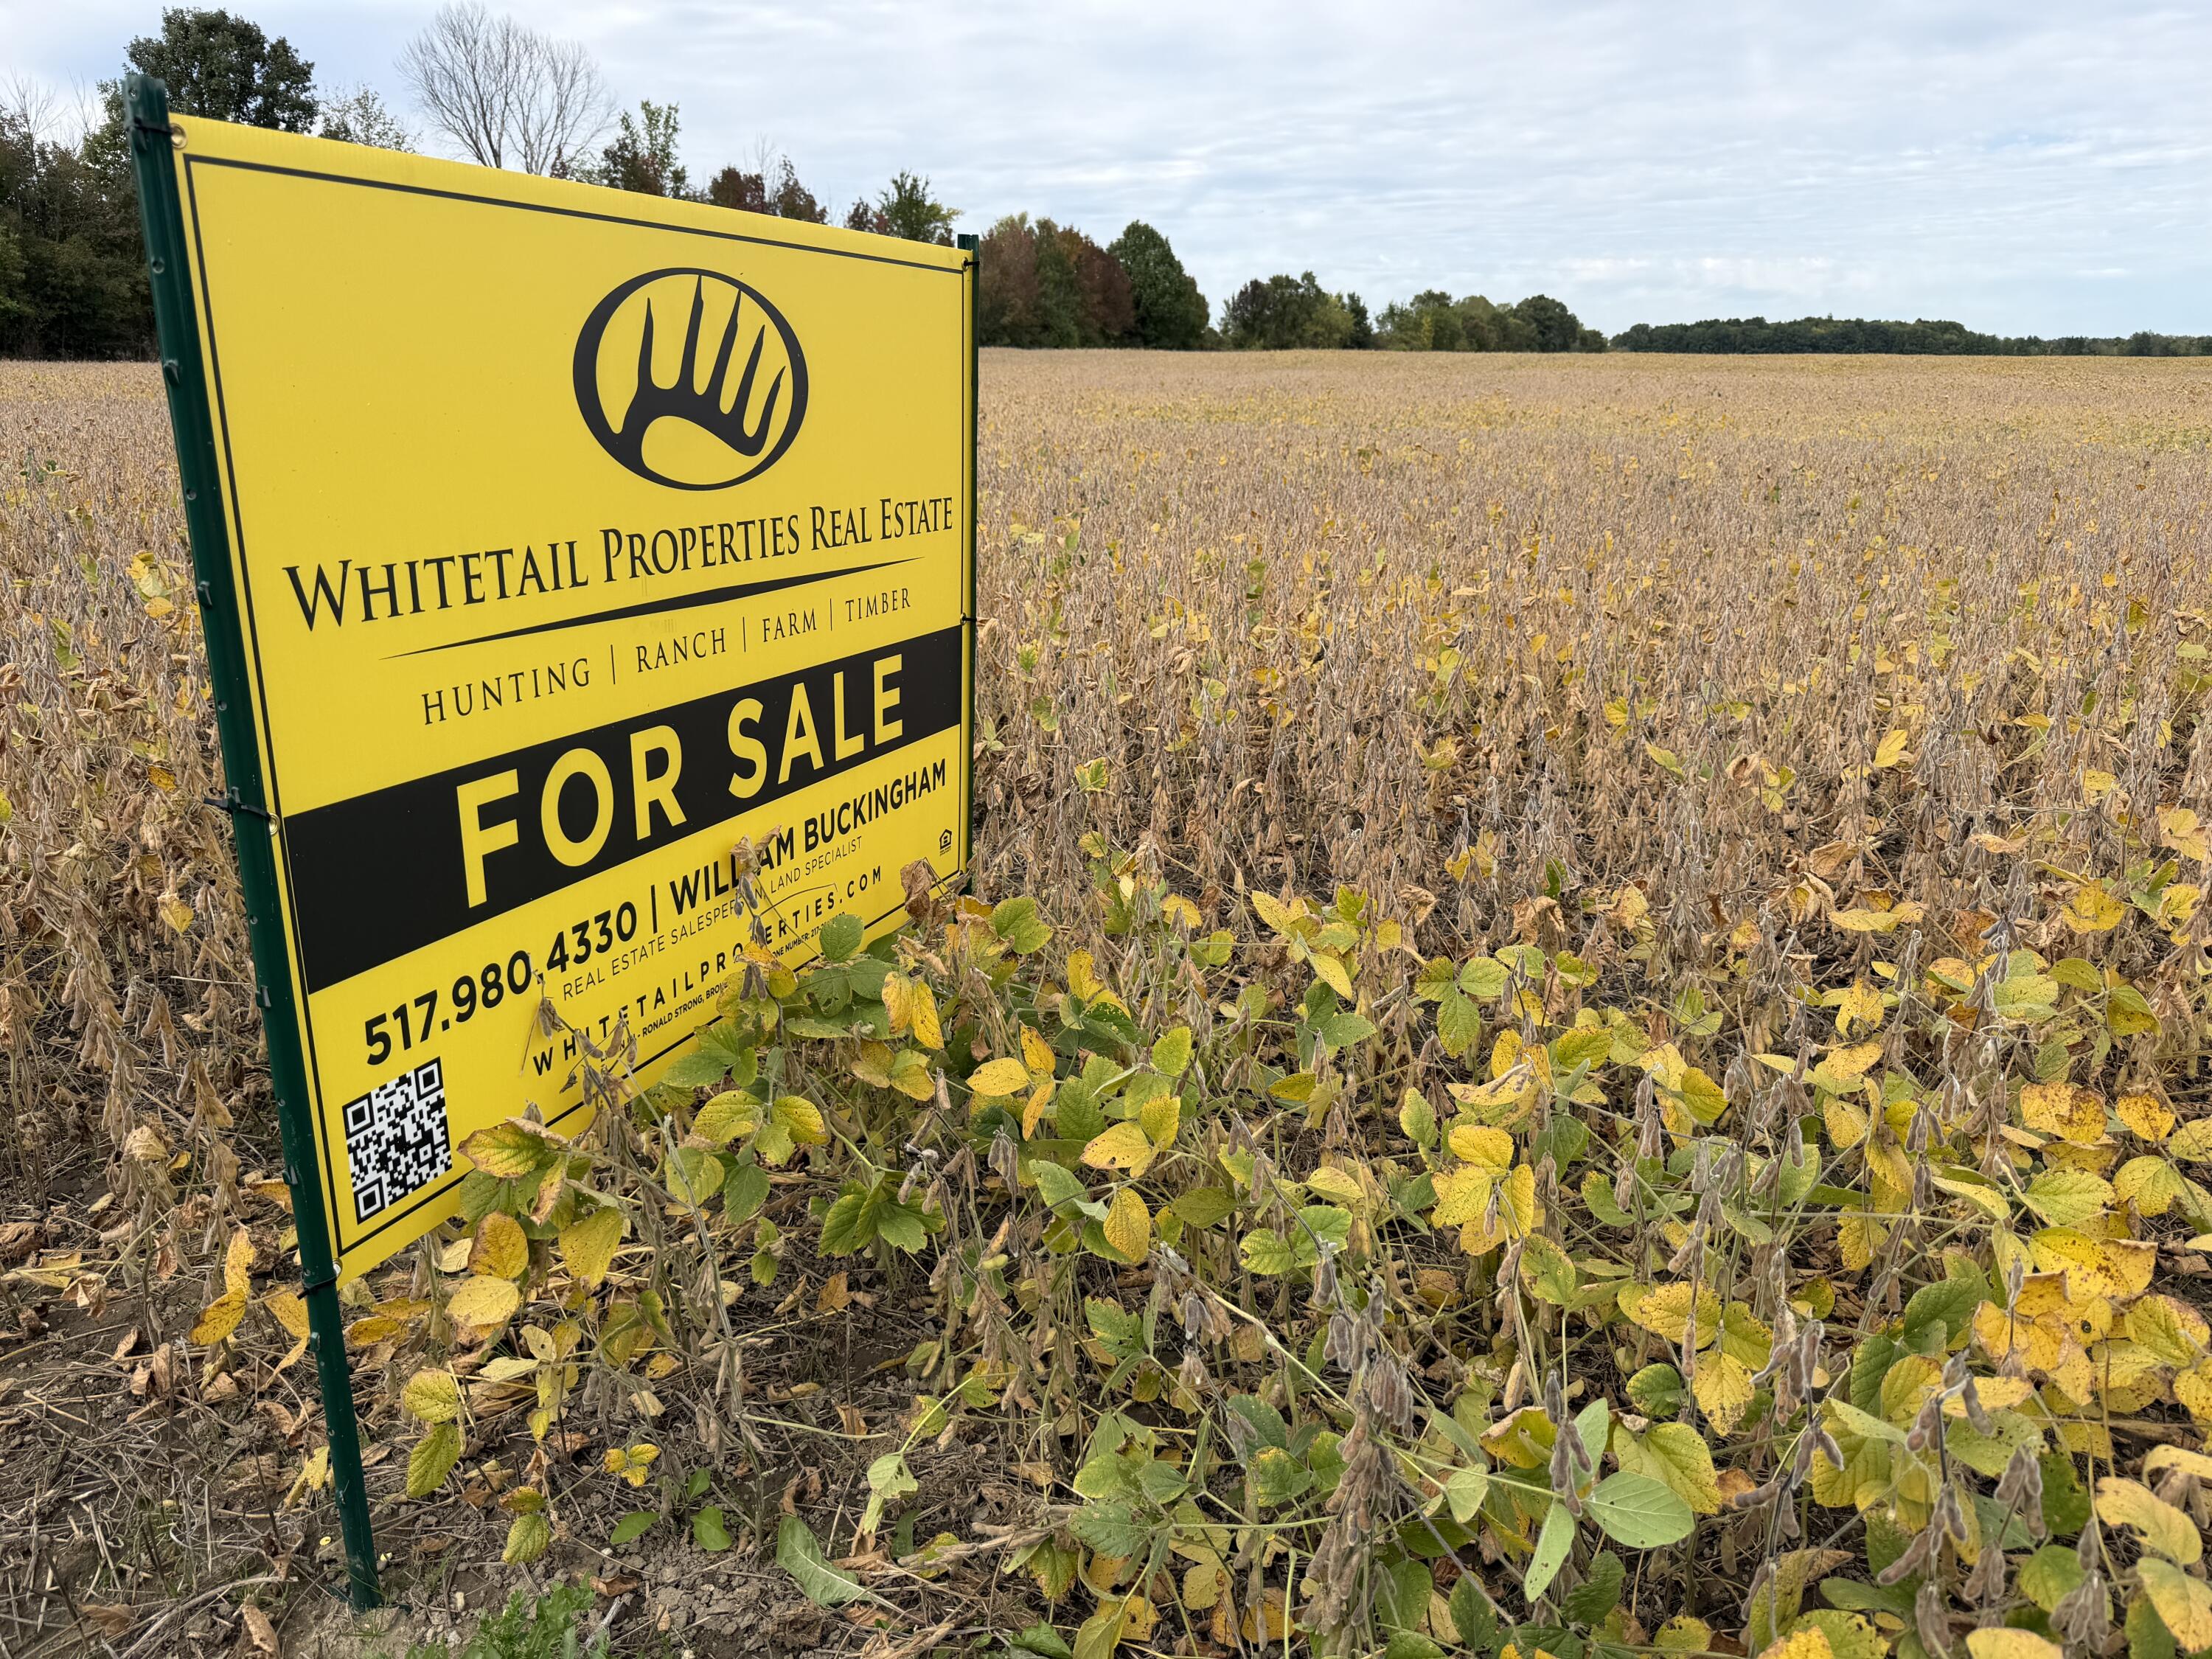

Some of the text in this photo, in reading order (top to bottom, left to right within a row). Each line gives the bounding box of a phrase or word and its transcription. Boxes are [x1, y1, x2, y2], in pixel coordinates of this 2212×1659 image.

[282, 497, 953, 632] WHITETAIL PROPERTIES REAL ESTATE
[421, 588, 911, 726] HUNTING RANCH FARM TIMBER
[456, 653, 903, 908] FOR SALE
[365, 758, 945, 1065] 517.980.4330 WILLAM BUCKINGHAM
[563, 967, 605, 1001] REAL
[612, 935, 665, 975] ESTATE
[771, 867, 801, 894] LAND
[805, 835, 862, 876] SPECIALIST
[642, 1012, 673, 1037] RONALD
[674, 994, 704, 1018] STRONG,
